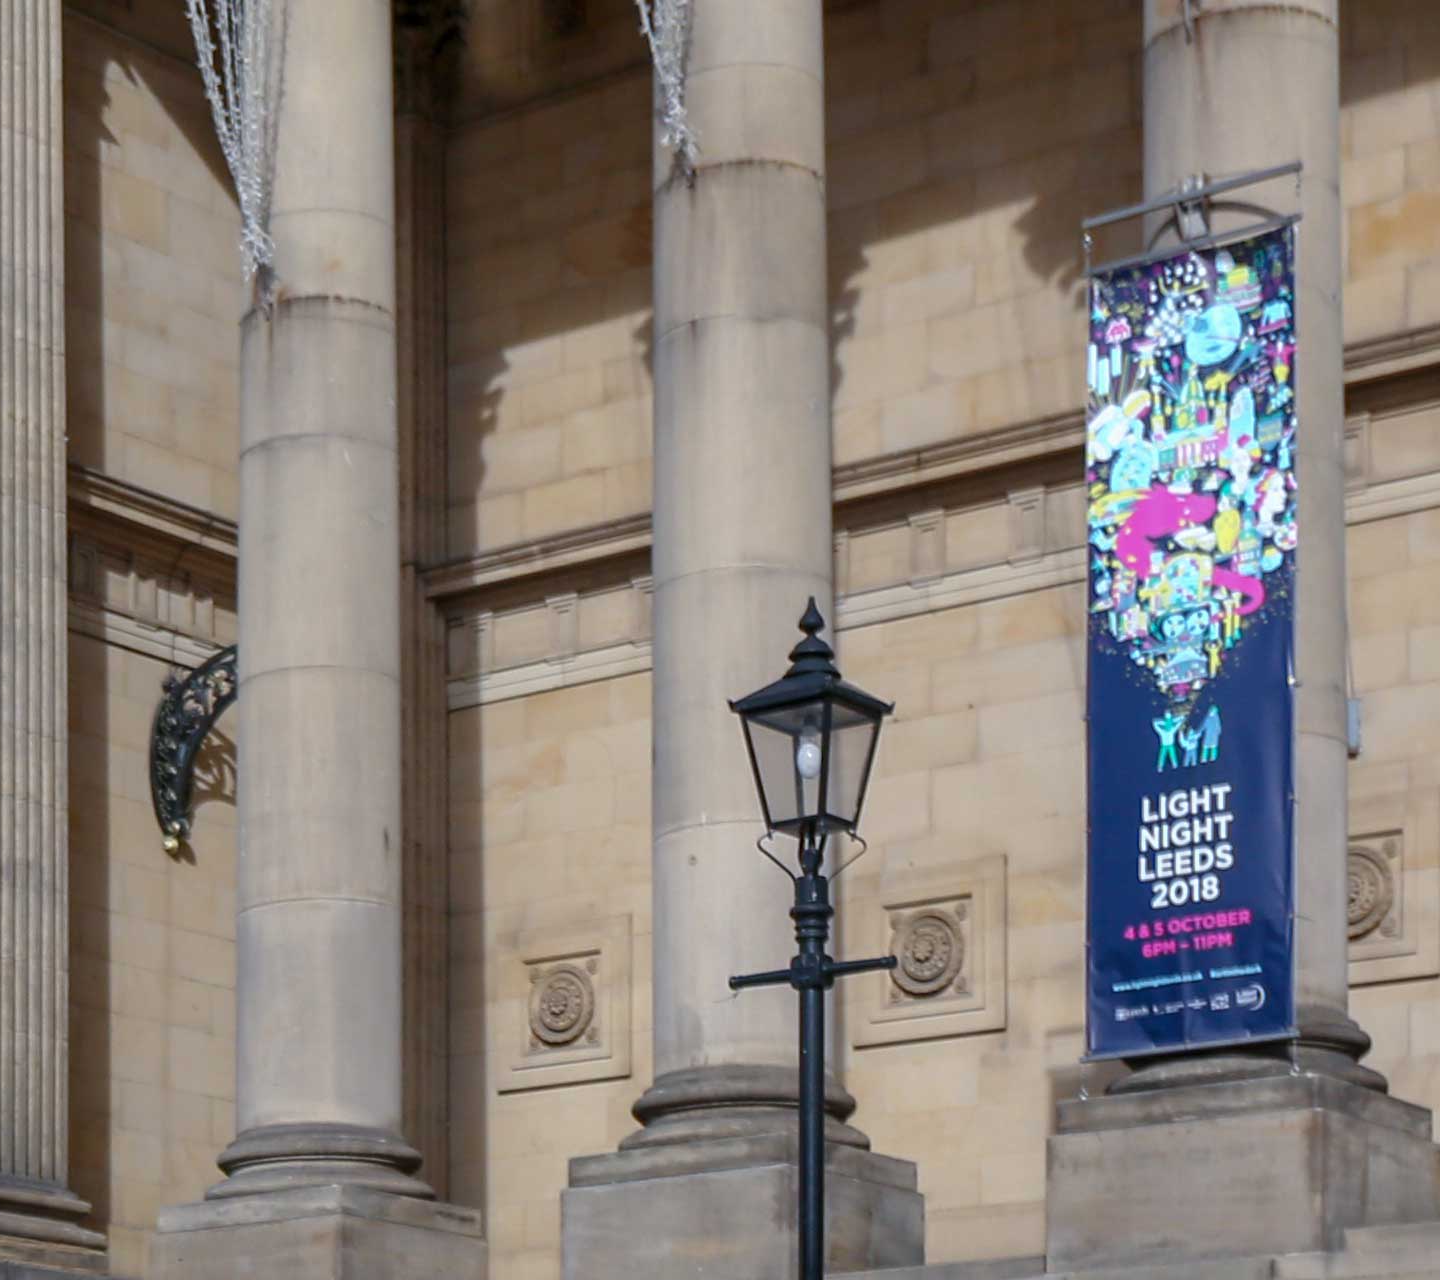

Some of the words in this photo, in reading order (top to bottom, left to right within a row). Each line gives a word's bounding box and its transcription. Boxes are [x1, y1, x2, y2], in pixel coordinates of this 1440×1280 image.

[1141, 783, 1232, 823] LIGHT
[1139, 815, 1233, 852] NIGHT
[1138, 845, 1233, 881] LEEDS
[1151, 876, 1219, 908] 2018
